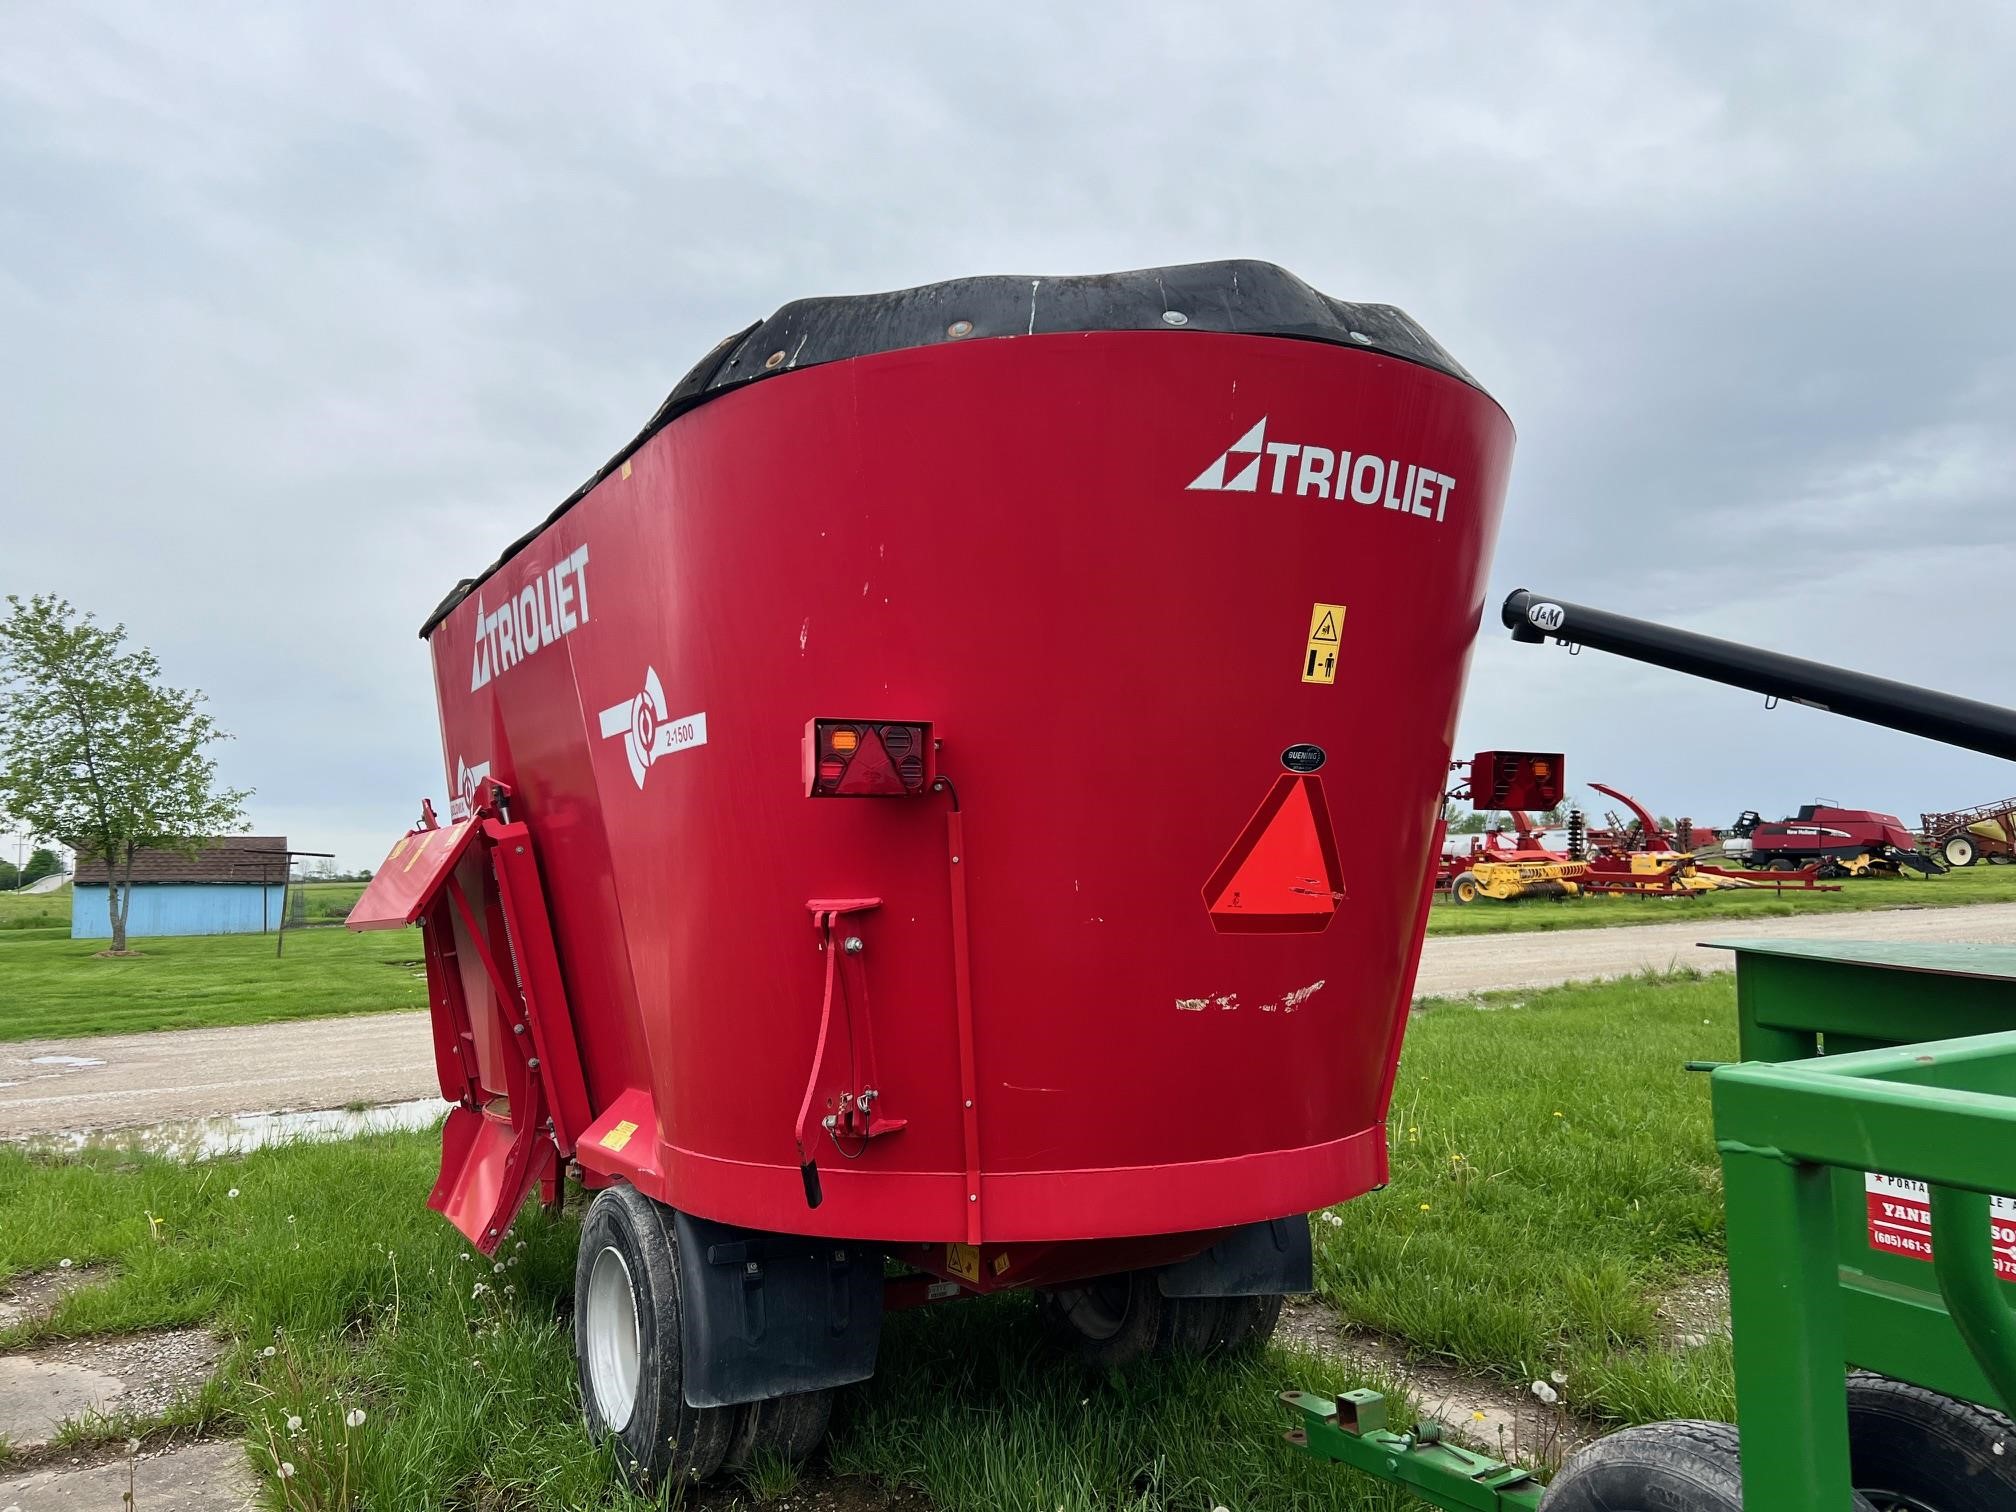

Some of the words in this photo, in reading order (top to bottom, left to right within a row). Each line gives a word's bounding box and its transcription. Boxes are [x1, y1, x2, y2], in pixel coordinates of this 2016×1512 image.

[1266, 441, 1456, 522] TRIOLIET
[485, 543, 589, 678] TRIOLIET
[1531, 606, 1562, 627] J&M
[666, 723, 694, 747] 2-1500
[1888, 1176, 1925, 1192] PORTA
